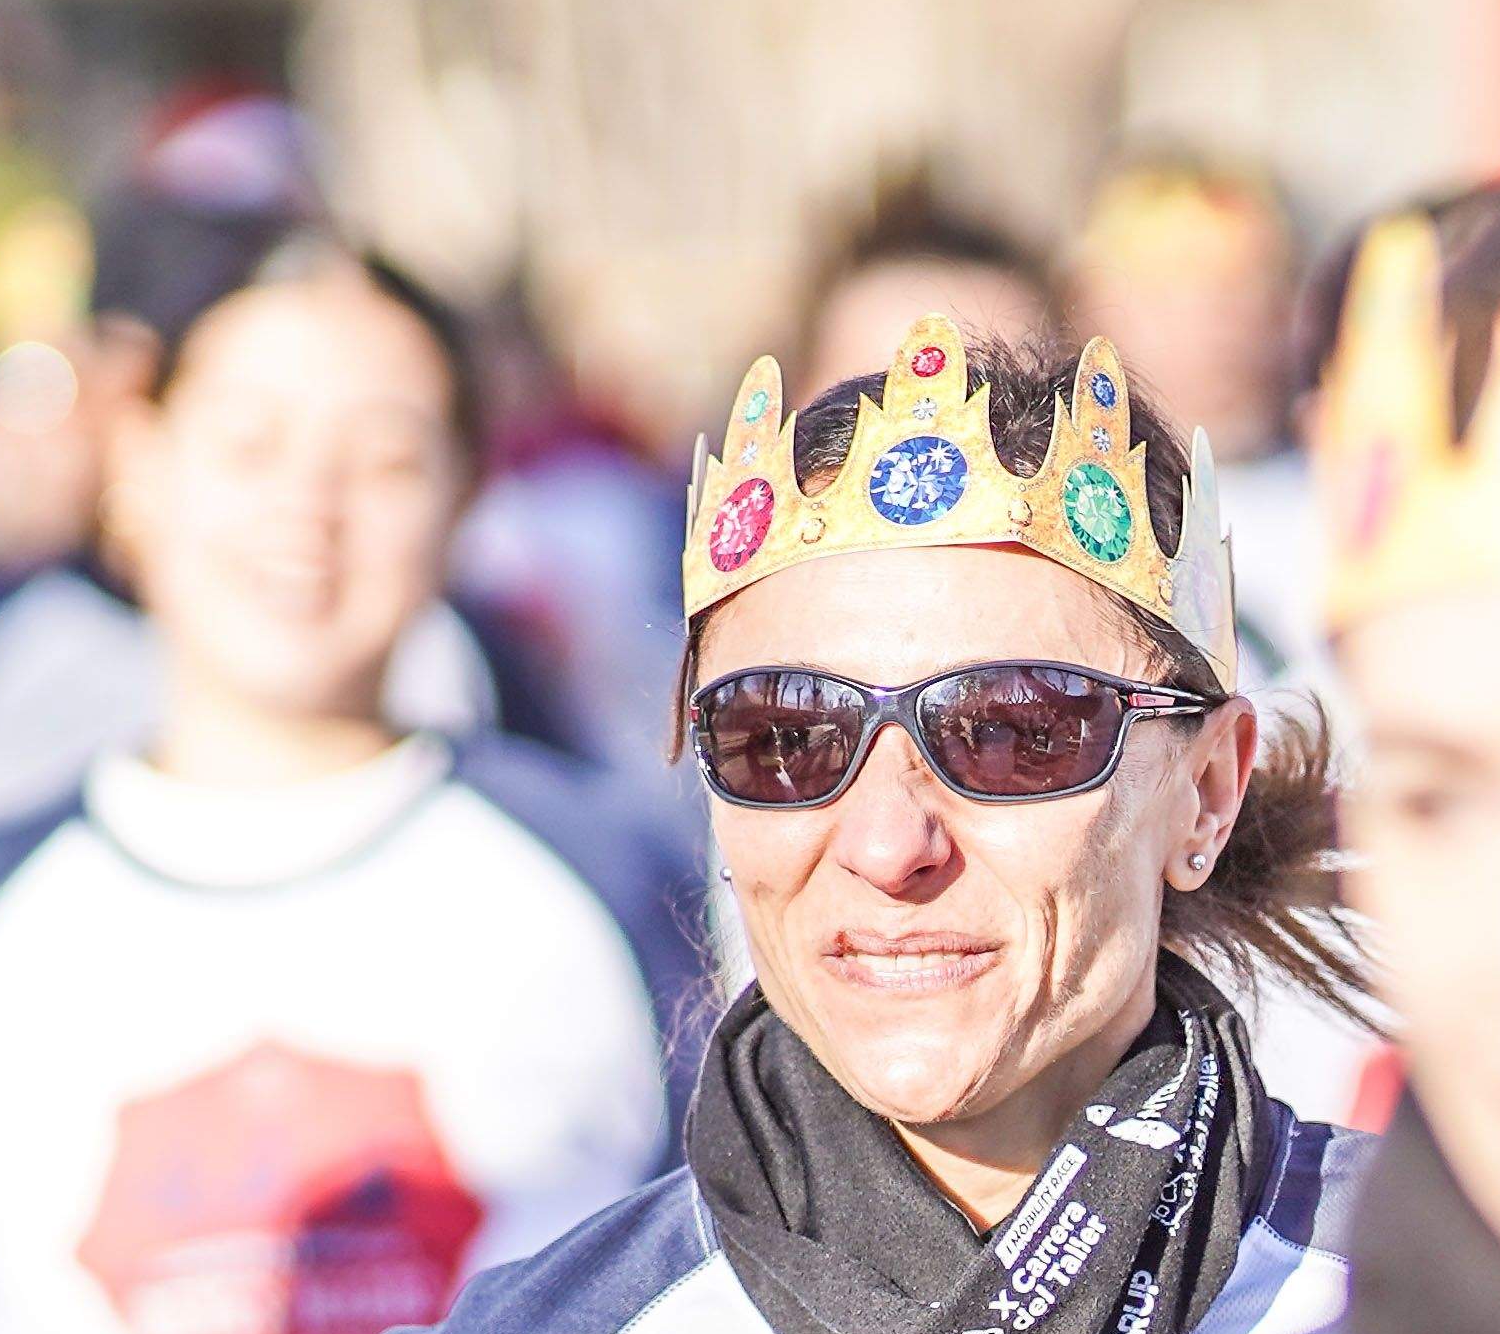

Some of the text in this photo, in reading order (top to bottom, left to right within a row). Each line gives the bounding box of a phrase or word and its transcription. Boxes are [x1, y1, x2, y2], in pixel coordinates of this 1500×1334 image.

[1012, 1189, 1051, 1247] MOBILITY
[1050, 1153, 1078, 1188] RACE
[988, 1201, 1087, 1321] X Carrera
[1012, 1214, 1107, 1331] del Taller
